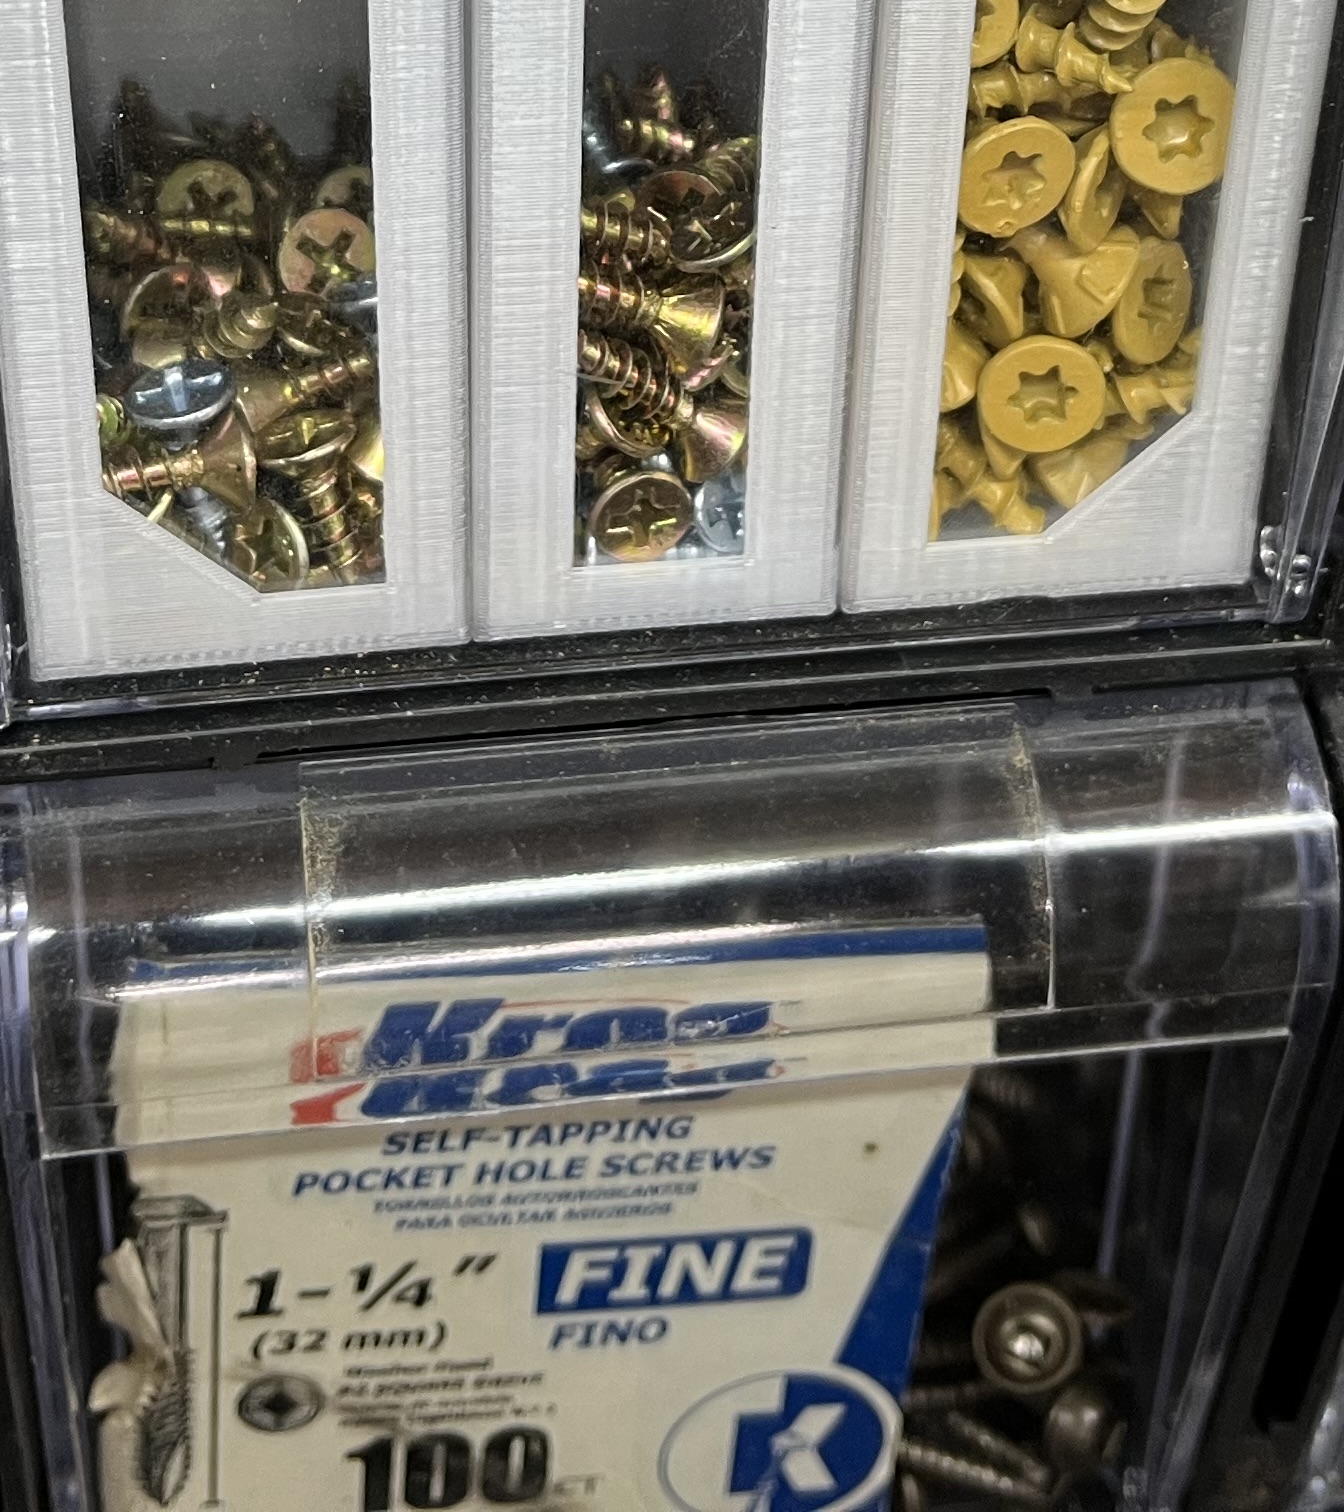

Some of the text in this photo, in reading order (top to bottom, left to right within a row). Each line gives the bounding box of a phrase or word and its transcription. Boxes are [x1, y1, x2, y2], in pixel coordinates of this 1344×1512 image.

[382, 1114, 696, 1157] SELF-TAPPING
[291, 1163, 465, 1197] POCKET
[473, 1156, 587, 1188] HOLE
[599, 1144, 777, 1178] SCREWS
[555, 1236, 796, 1307] FINE
[252, 1320, 448, 1361] (32 mm)
[548, 1316, 669, 1351] FINO
[343, 1422, 551, 1512] 100
